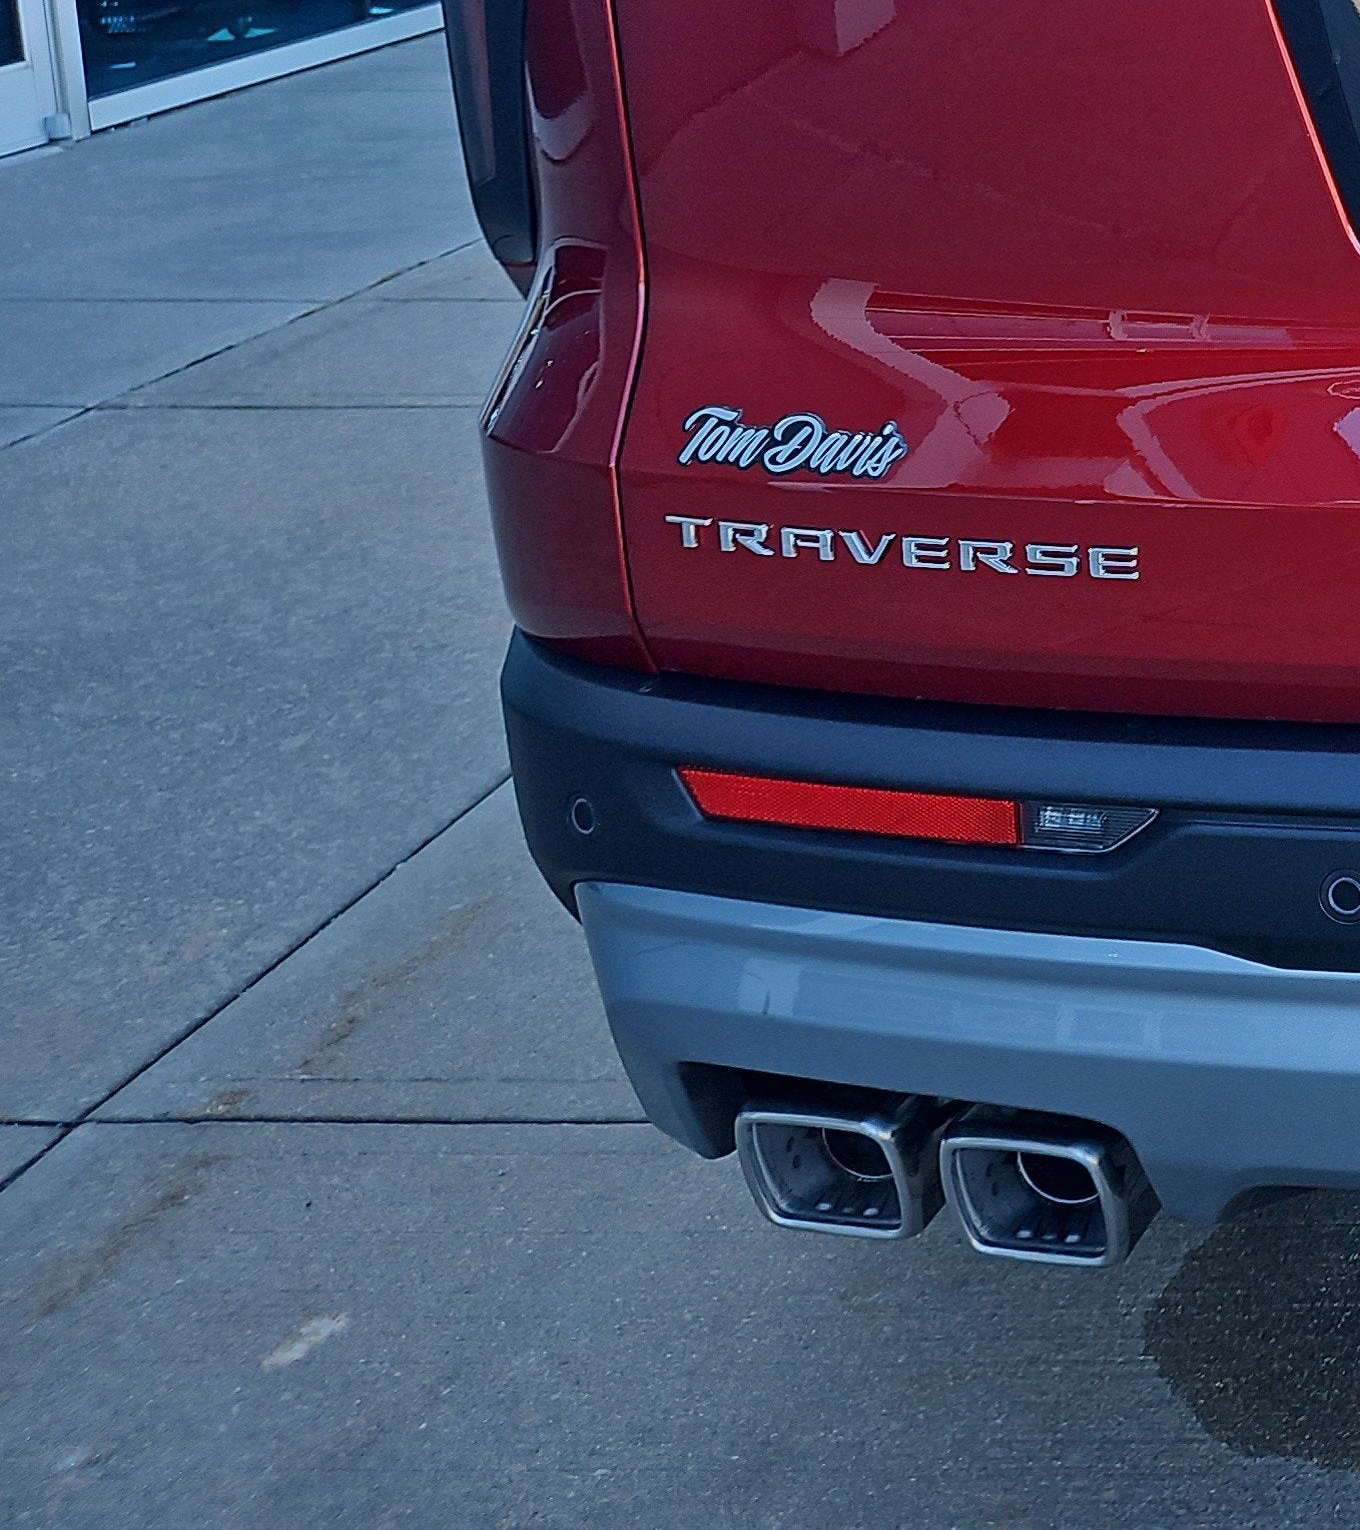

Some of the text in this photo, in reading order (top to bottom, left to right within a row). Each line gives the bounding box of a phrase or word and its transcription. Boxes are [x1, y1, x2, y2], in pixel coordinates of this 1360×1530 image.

[679, 407, 905, 477] Tom Davis
[664, 515, 1140, 580] TRAVERSE
